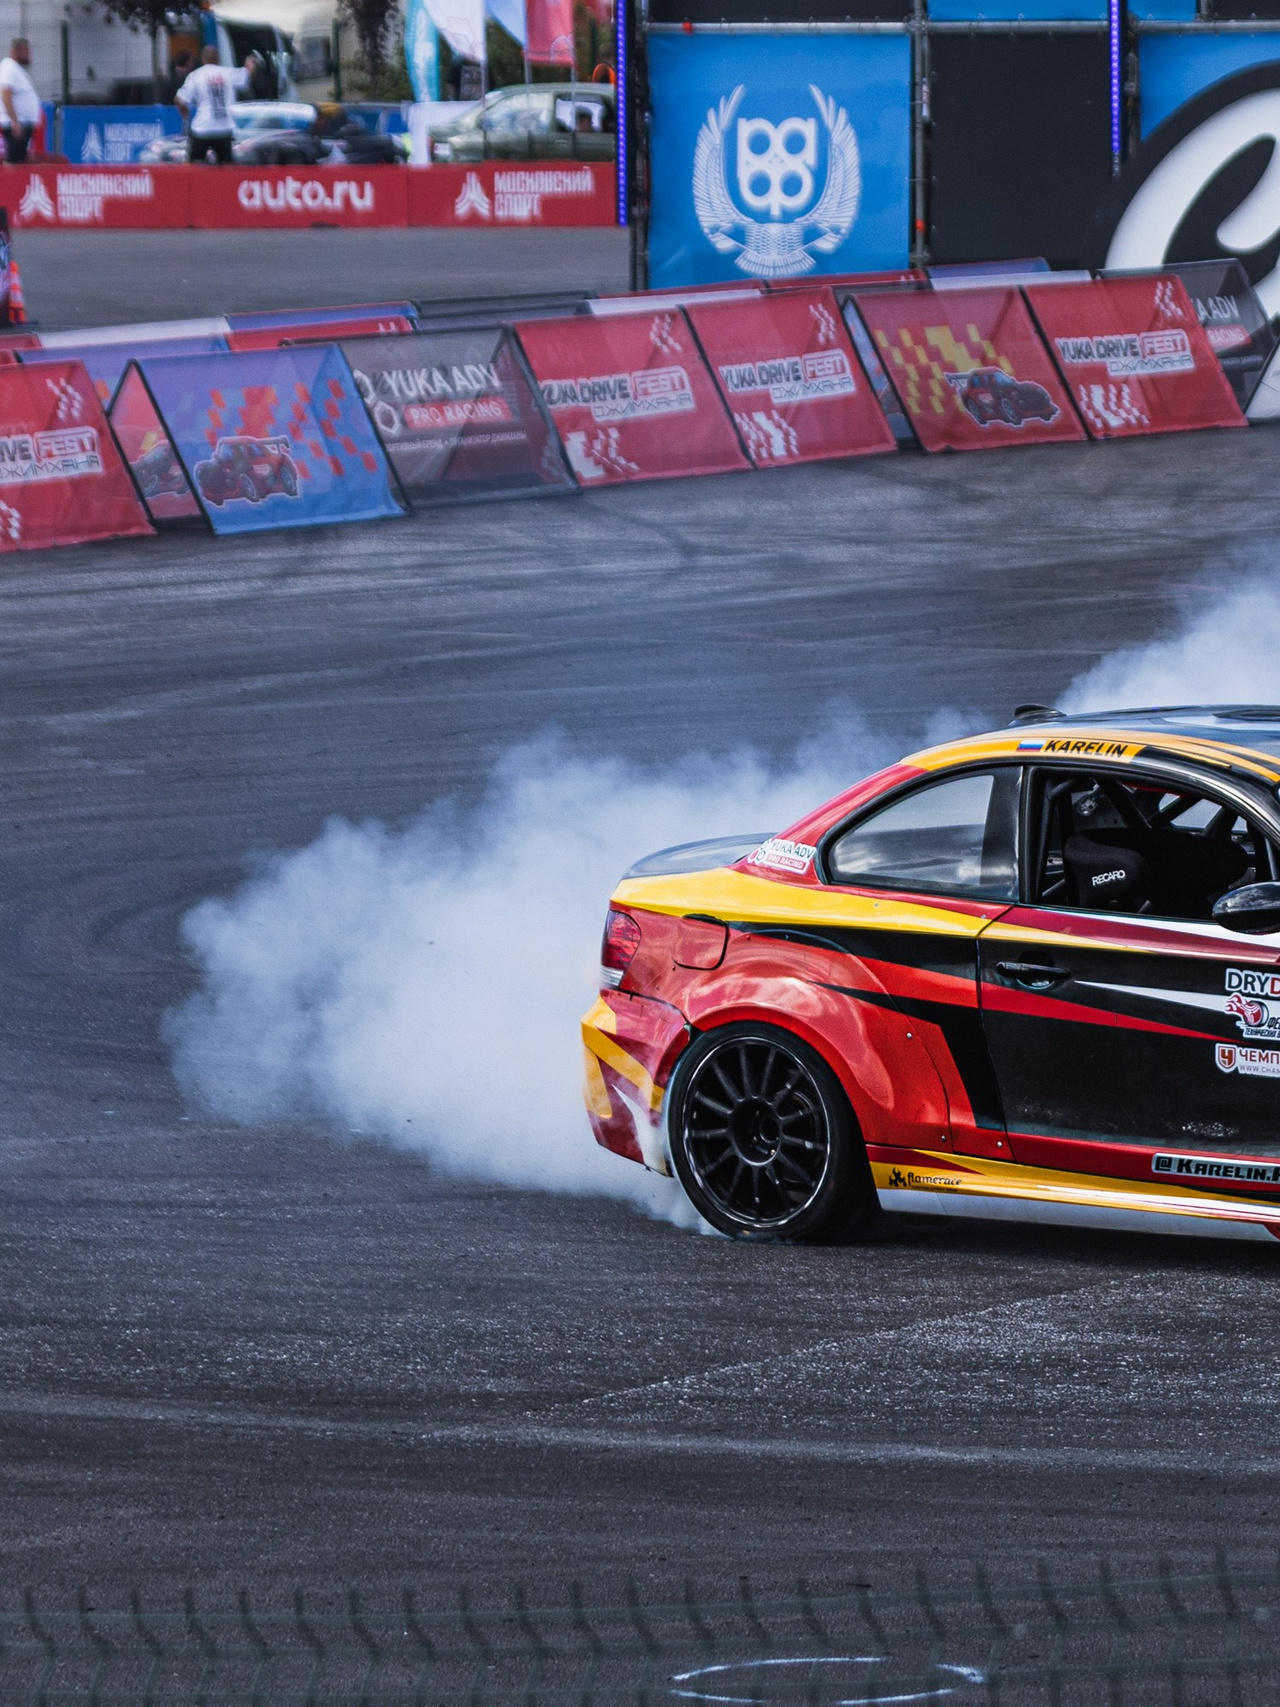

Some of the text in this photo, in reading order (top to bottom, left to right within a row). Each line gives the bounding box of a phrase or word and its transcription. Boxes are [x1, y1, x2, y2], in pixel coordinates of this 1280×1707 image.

[238, 176, 374, 212] auto.ru
[1207, 295, 1240, 319] ADV
[1057, 335, 1185, 361] YUKA DRIVE FEST
[382, 363, 500, 397] YUKA ADV
[720, 356, 846, 390] YUKA DRIVE FEST
[579, 378, 631, 404] DRIVE
[636, 374, 683, 397] FEST
[409, 401, 502, 425] PRO RACING
[39, 433, 95, 458] FEST
[1045, 739, 1128, 758] KARELIN
[771, 841, 815, 859] YUKA ADV
[1092, 869, 1126, 886] RECARO
[907, 1171, 963, 1186] flamerace
